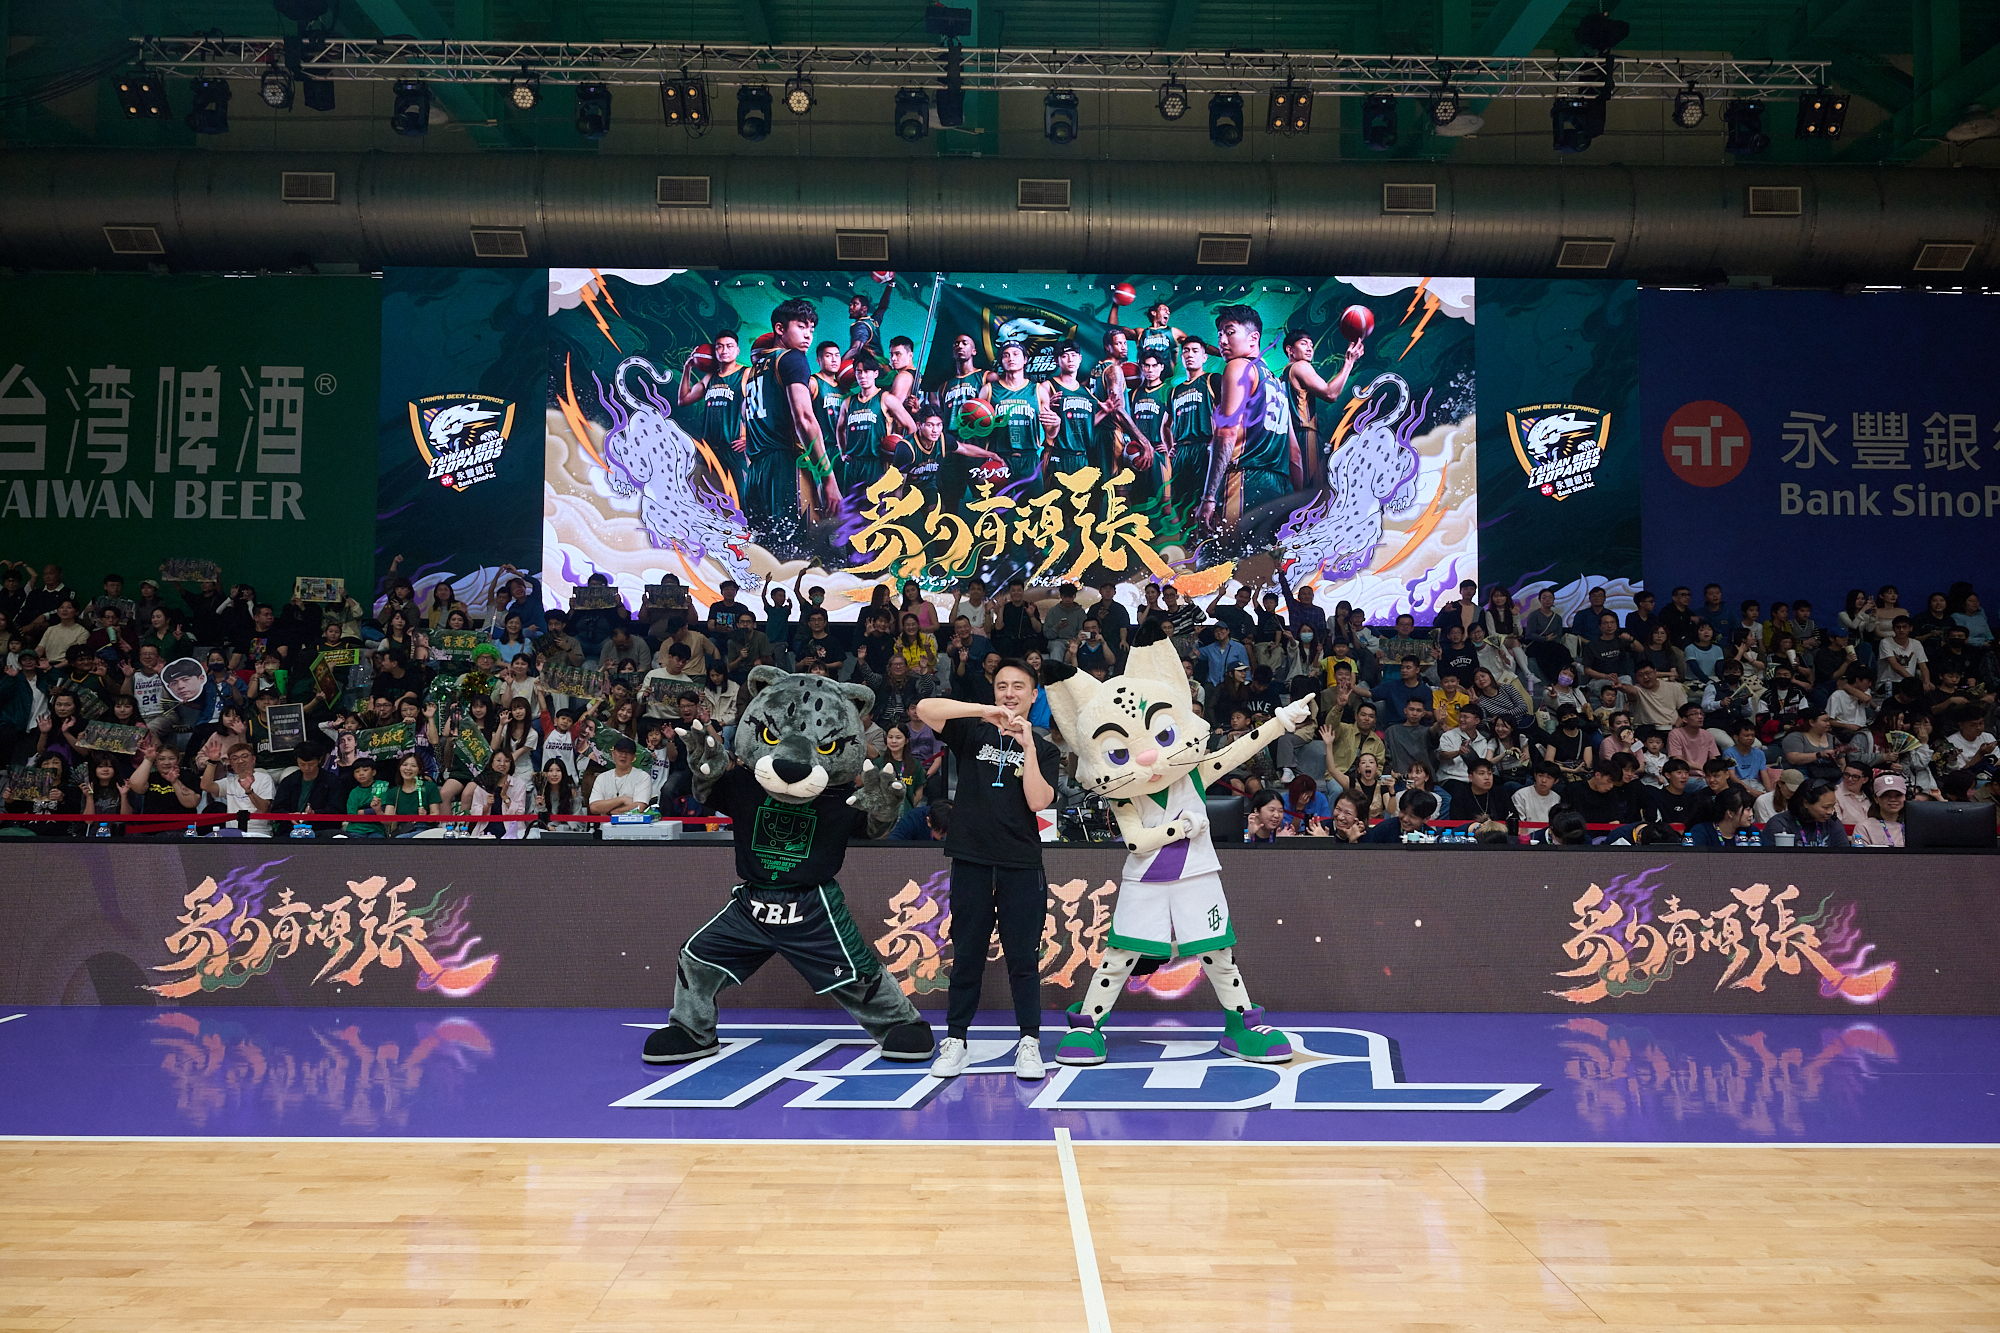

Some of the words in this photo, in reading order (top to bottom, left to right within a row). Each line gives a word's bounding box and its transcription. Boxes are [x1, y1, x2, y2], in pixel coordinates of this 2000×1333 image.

[431, 446, 474, 468] TAIWAN
[474, 437, 504, 453] BEER
[1780, 411, 2000, 471] 永豐銀
[428, 445, 504, 480] LEOPARDS
[1527, 455, 1601, 489] LEOPARDS
[1530, 456, 1571, 477] TAIWAN
[1572, 446, 1601, 463] BEER
[174, 480, 306, 520] BEER
[1780, 482, 1882, 516] Bank
[142, 693, 158, 706] 24
[652, 769, 659, 780] 5
[1884, 776, 1894, 785] C
[750, 899, 804, 925] T.B.L
